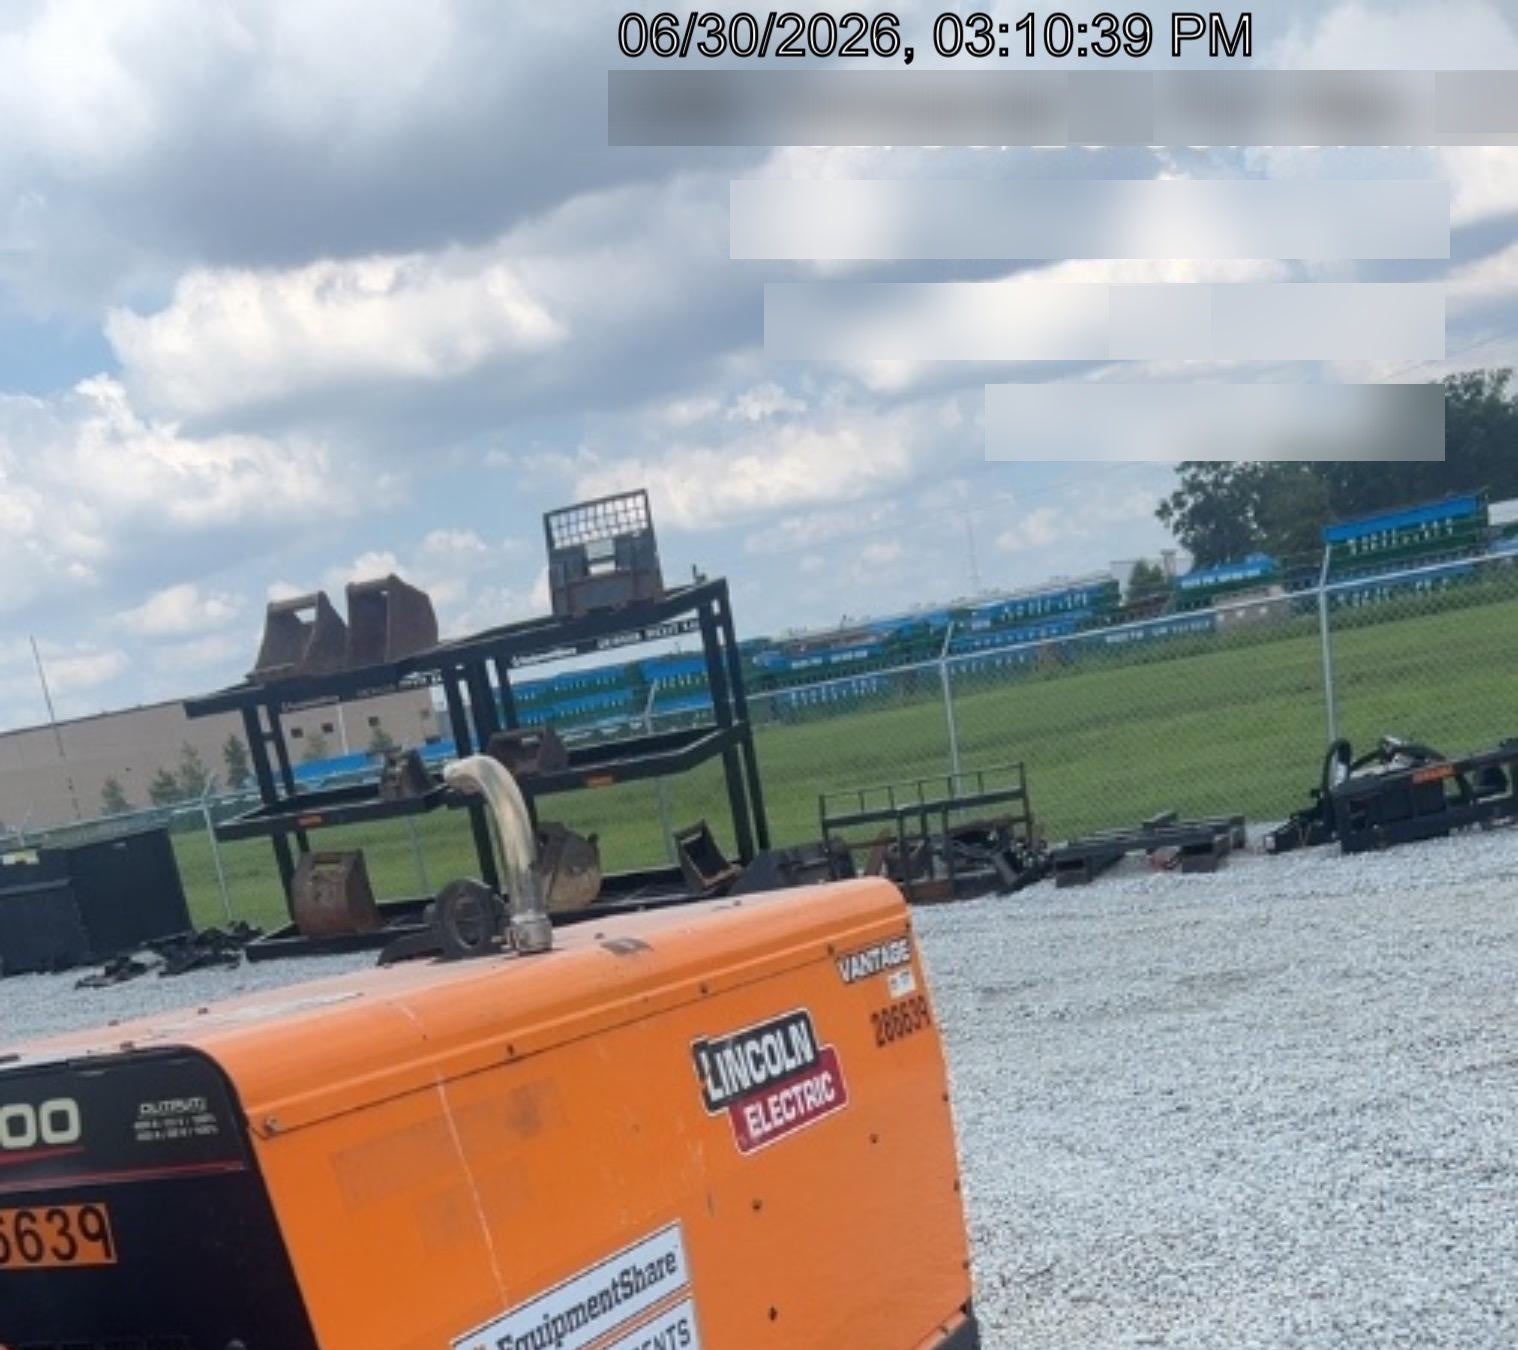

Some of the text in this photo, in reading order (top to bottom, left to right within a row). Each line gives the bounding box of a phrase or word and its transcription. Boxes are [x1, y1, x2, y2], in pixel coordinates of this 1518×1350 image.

[838, 938, 911, 983] VANTAGE
[699, 1019, 815, 1101] LINCOLN
[743, 1070, 836, 1140] ELECTRIC
